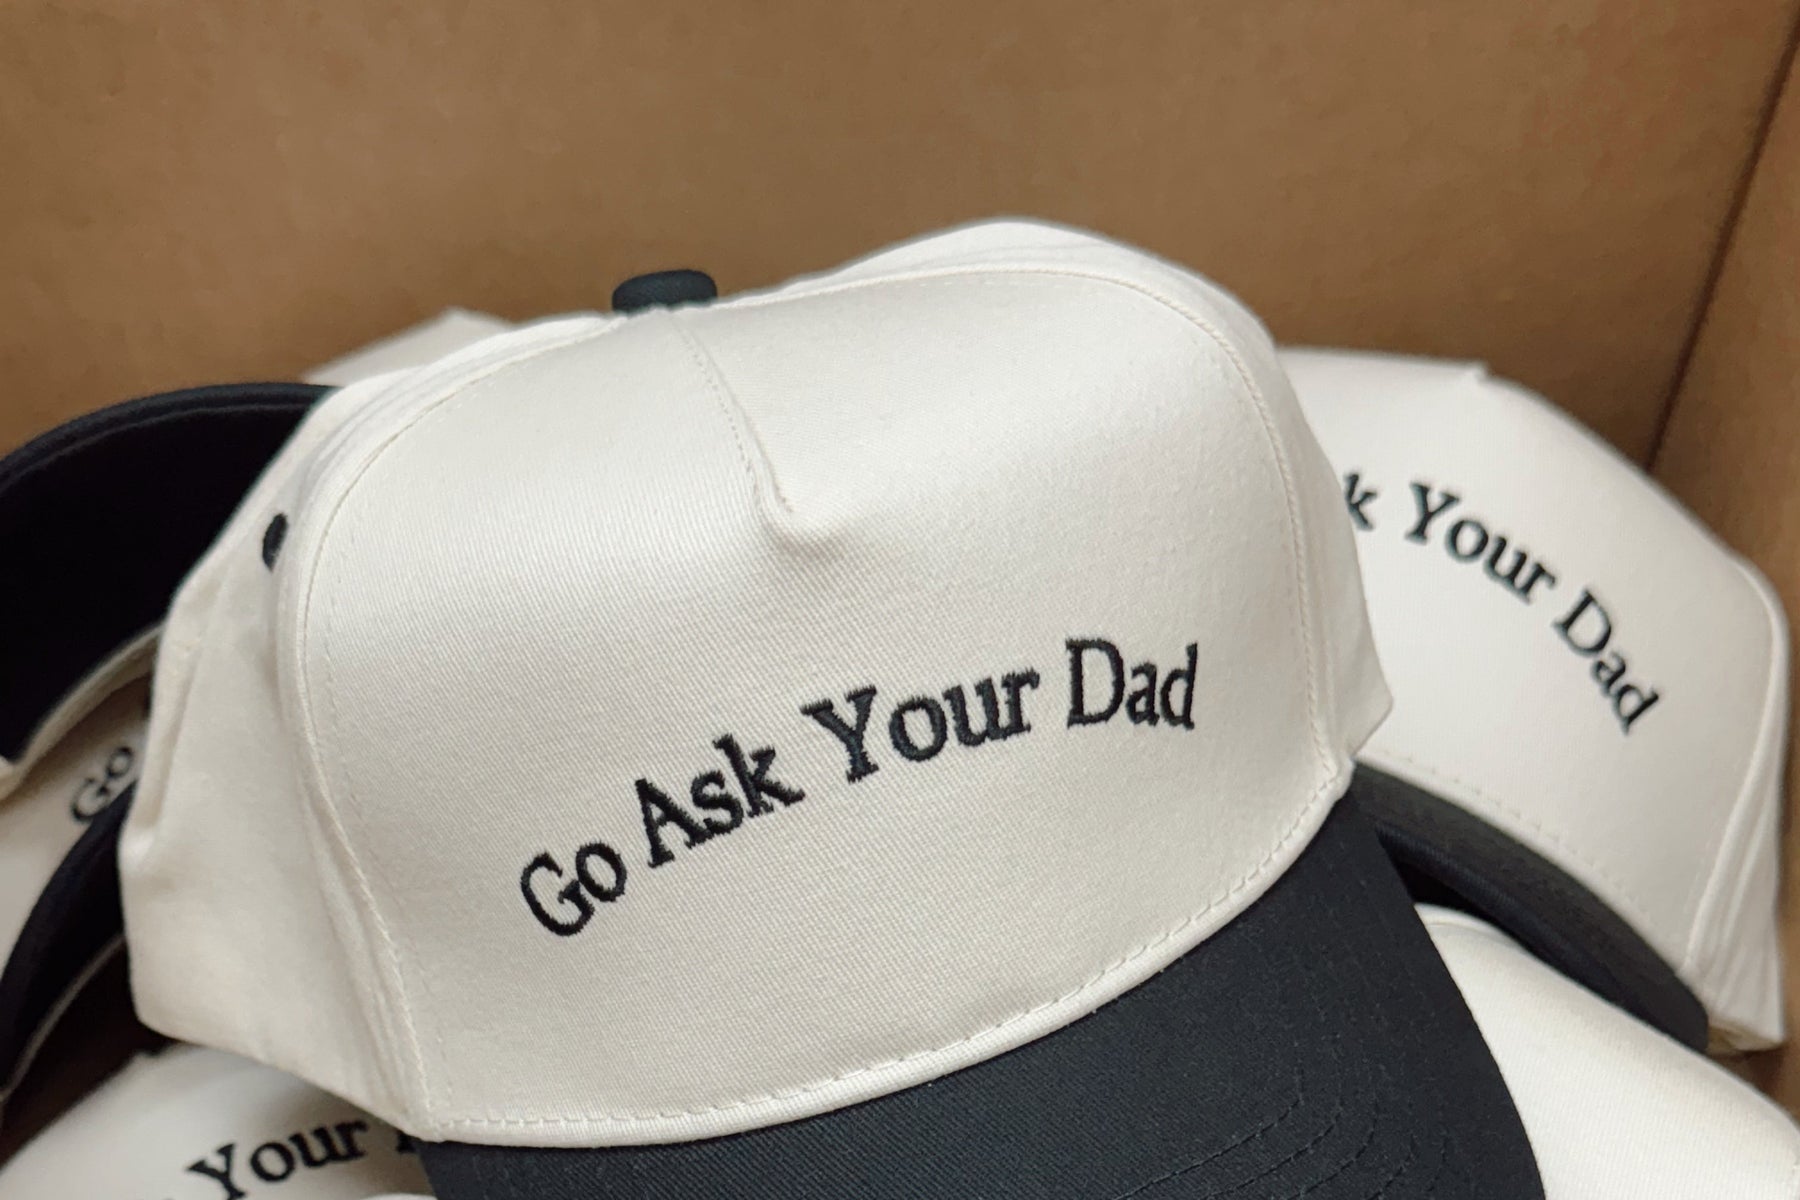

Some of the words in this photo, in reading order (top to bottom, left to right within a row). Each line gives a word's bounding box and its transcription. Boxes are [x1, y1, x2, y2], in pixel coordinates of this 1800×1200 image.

[1404, 480, 1556, 605] Your
[1551, 586, 1659, 736] Dad
[70, 747, 133, 822] Go
[520, 842, 627, 937] Go
[634, 734, 805, 868] Ask
[800, 668, 1040, 783] Your
[1065, 637, 1198, 730] Dad
